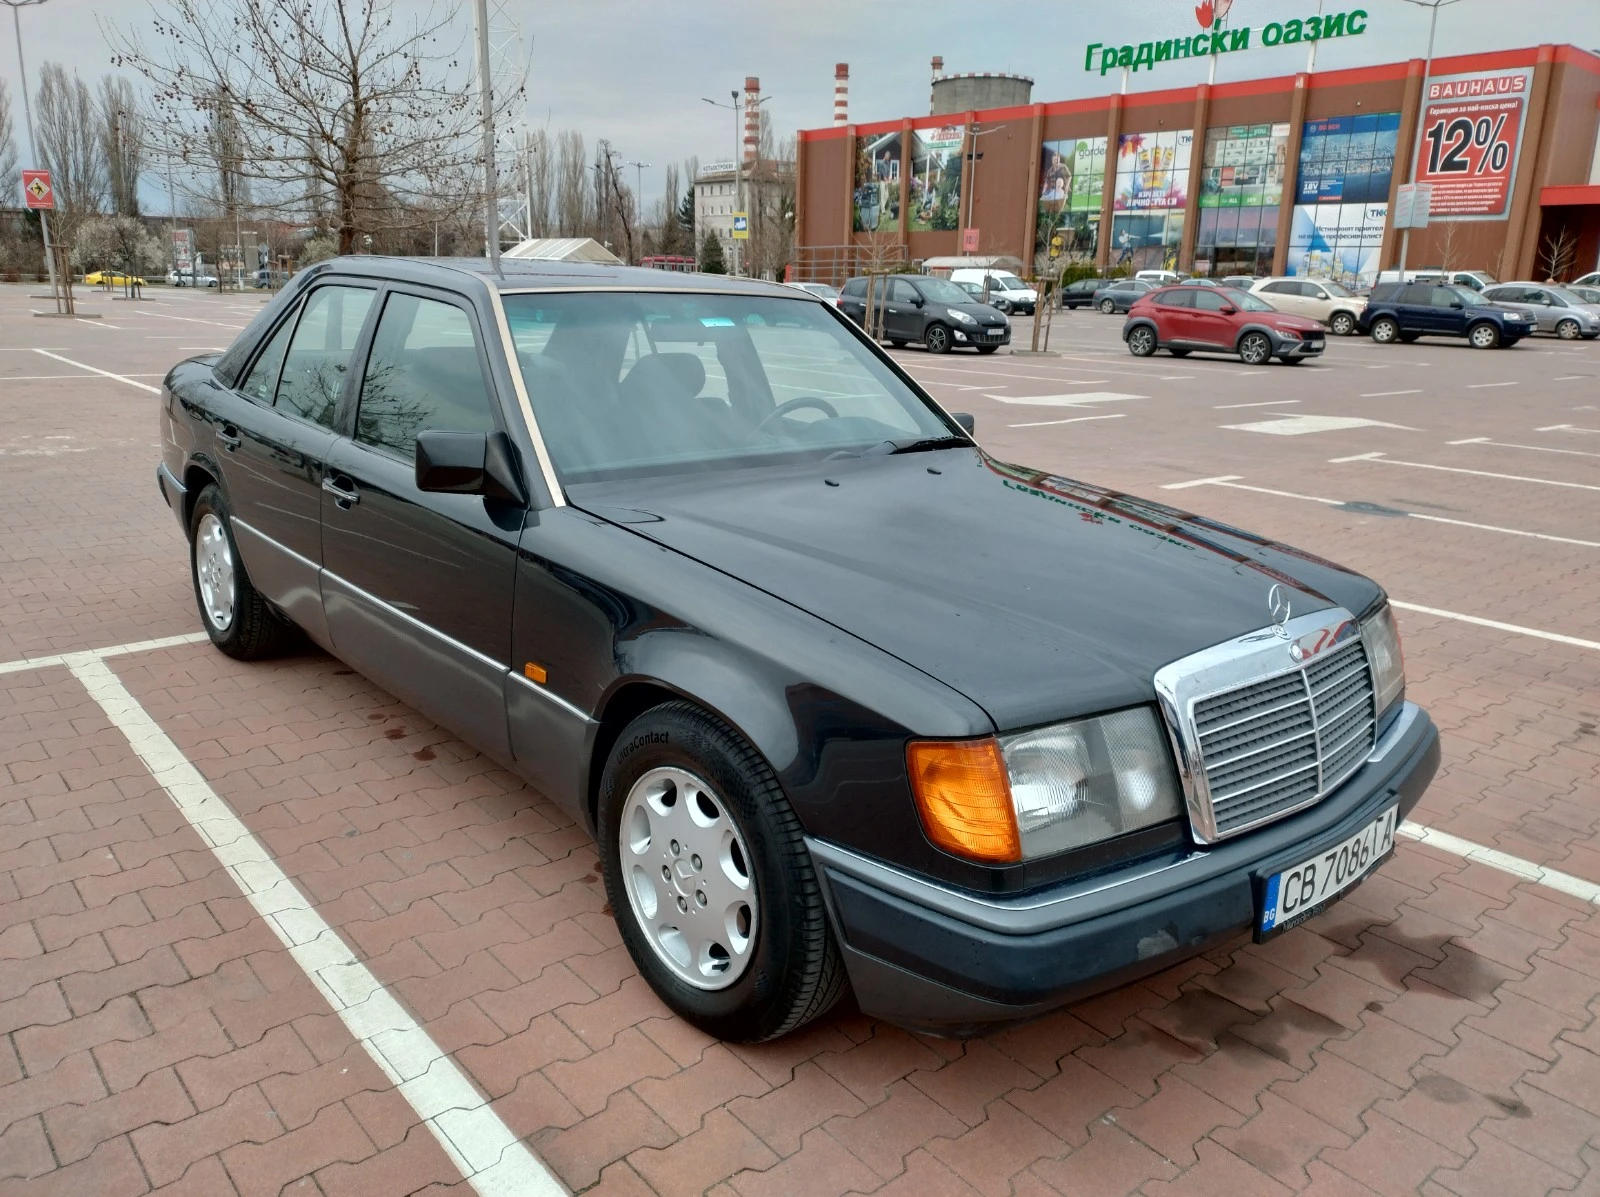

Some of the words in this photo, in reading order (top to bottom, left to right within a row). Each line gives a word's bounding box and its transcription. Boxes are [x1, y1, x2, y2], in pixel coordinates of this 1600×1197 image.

[1084, 18, 1250, 76] Градински
[1261, 9, 1368, 47] оазис
[1429, 76, 1526, 98] BAUHAUS
[1430, 107, 1458, 116] Гаранция
[1467, 103, 1499, 112] най-ниска
[1499, 101, 1518, 110] цена!
[1426, 113, 1509, 175] 12%
[1282, 863, 1317, 914] CB
[1320, 829, 1370, 896] 7086
[1263, 908, 1276, 923] BG
